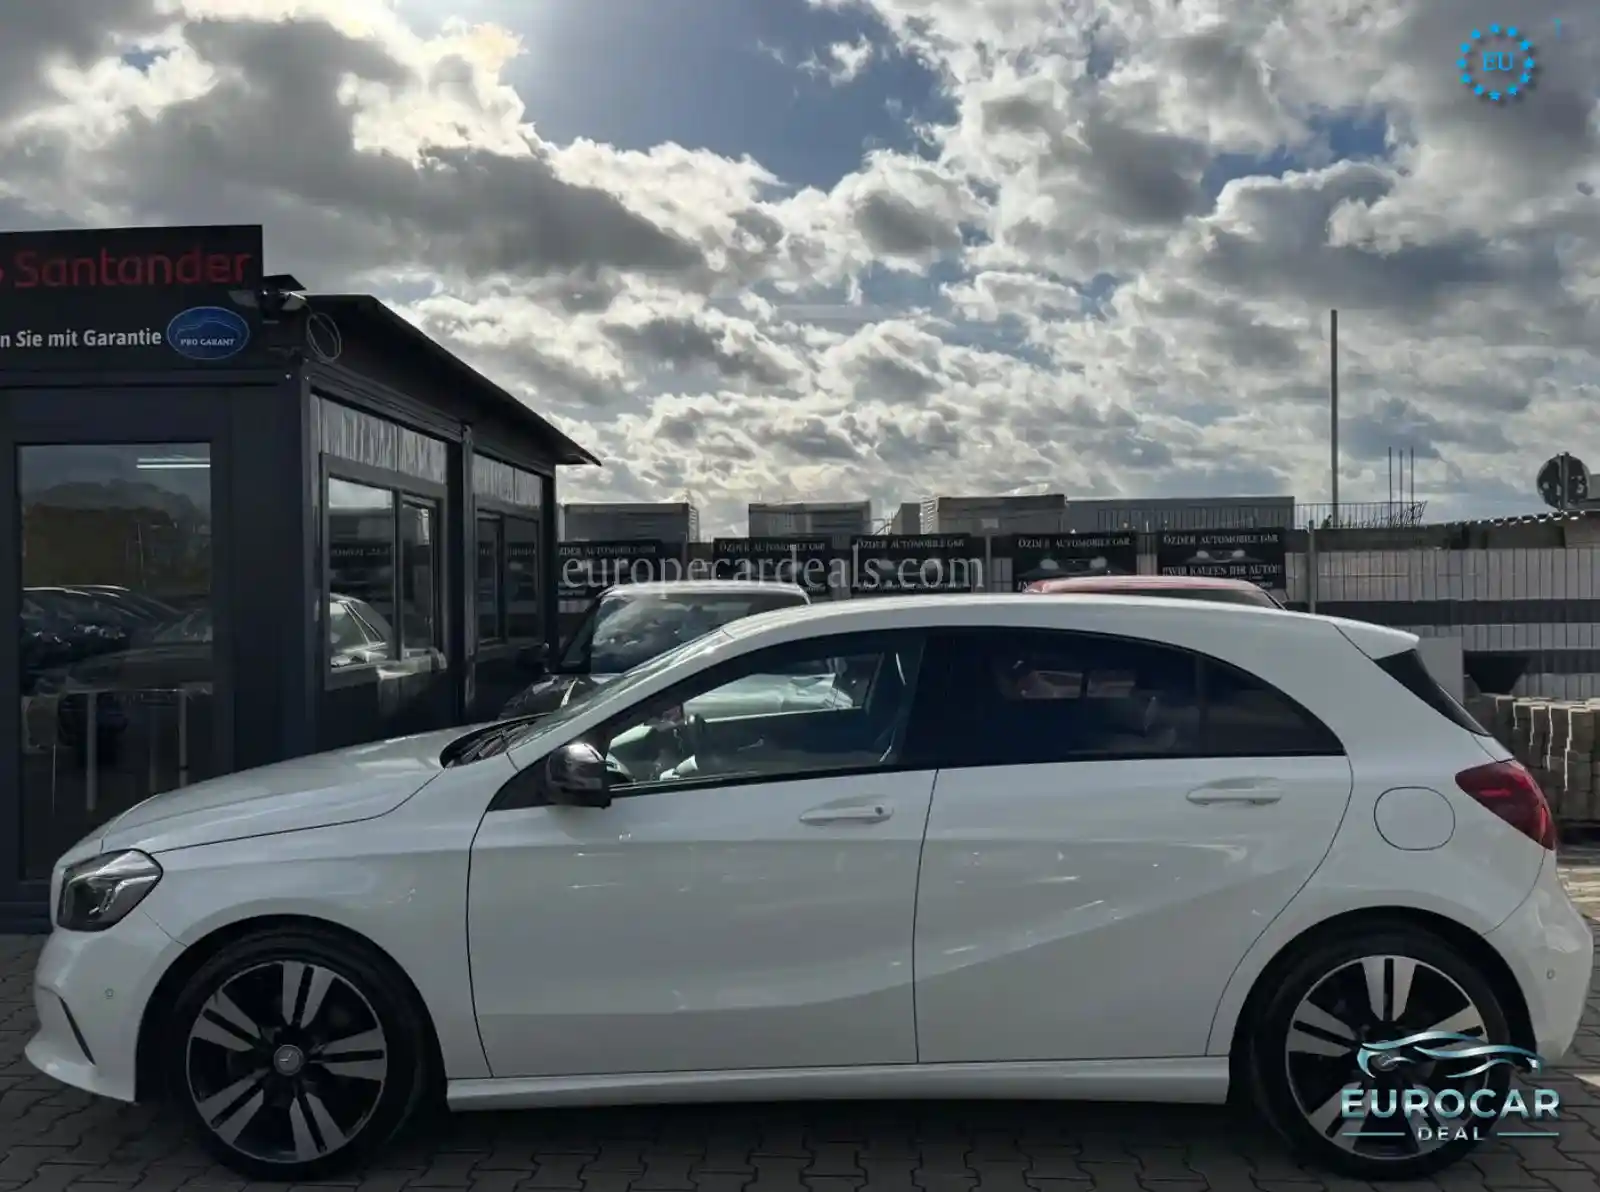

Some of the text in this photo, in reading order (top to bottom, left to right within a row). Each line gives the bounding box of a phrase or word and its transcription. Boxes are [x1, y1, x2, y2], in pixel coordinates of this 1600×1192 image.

[14, 246, 252, 288] Santander
[16, 329, 42, 347] Sie
[48, 328, 78, 347] mit
[83, 328, 162, 346] Garantie
[180, 338, 236, 346] PRO GARANT
